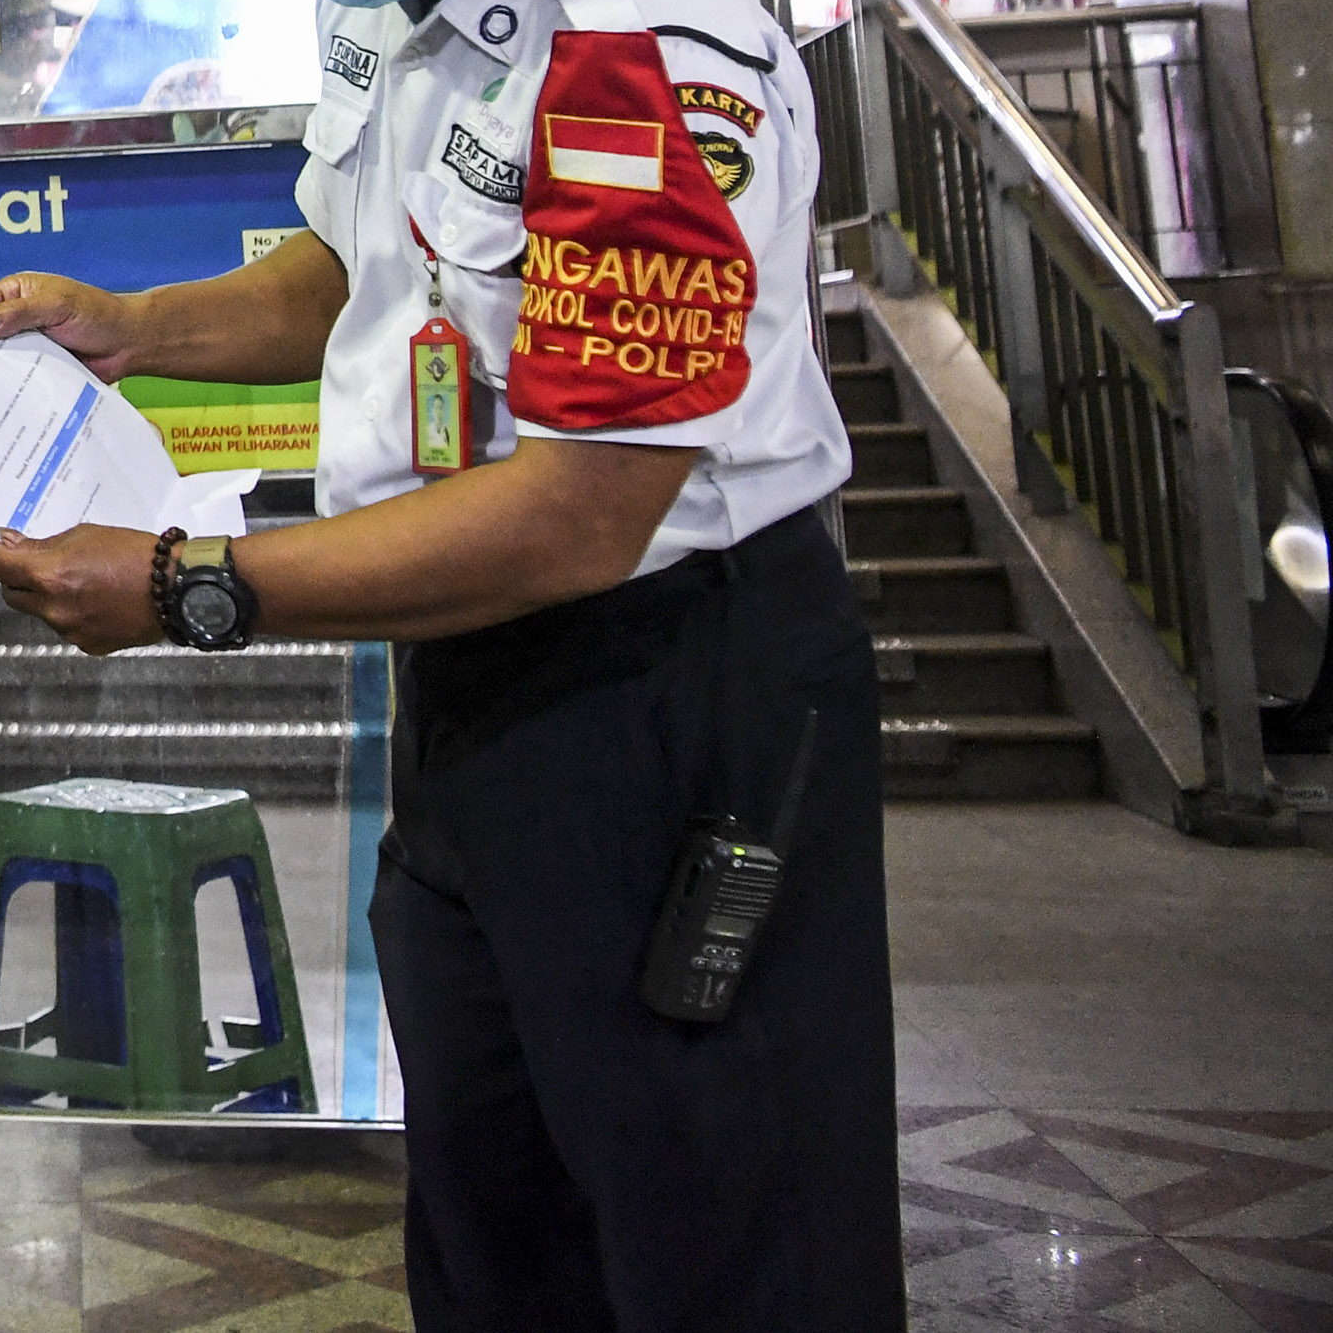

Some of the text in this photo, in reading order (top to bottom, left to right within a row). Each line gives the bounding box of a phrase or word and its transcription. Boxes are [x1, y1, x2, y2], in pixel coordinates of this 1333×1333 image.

[521, 232, 747, 305] NGAWAS
[612, 298, 744, 346] COVID-19
[171, 423, 320, 439] DILARANG MEMBAWA
[172, 439, 311, 454] HEWAN PELIHARAAN
